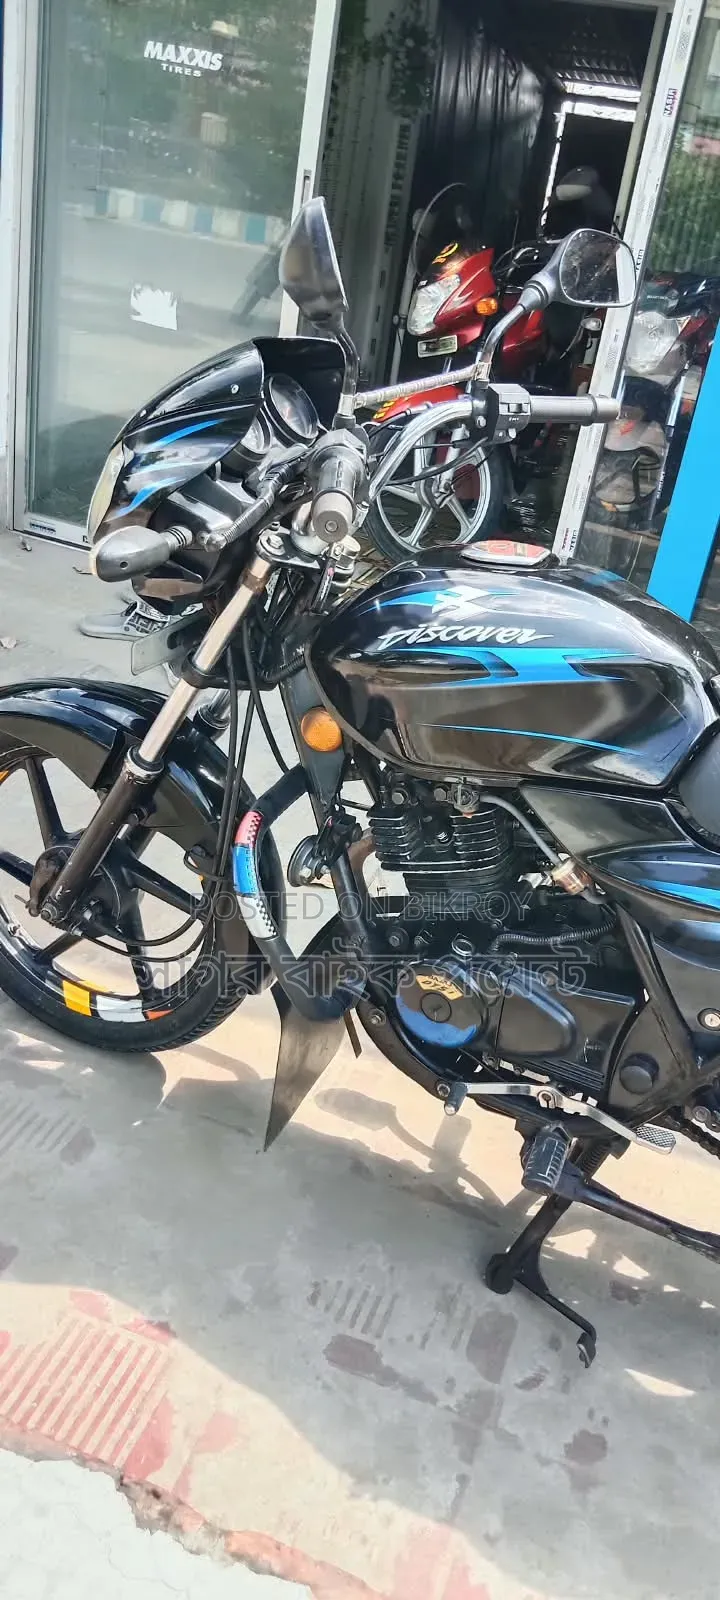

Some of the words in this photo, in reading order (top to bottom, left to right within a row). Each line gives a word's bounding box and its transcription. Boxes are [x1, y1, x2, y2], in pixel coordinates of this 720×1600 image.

[143, 40, 224, 71] MAXXIS
[161, 63, 202, 77] TIRES
[377, 623, 554, 651] Discover
